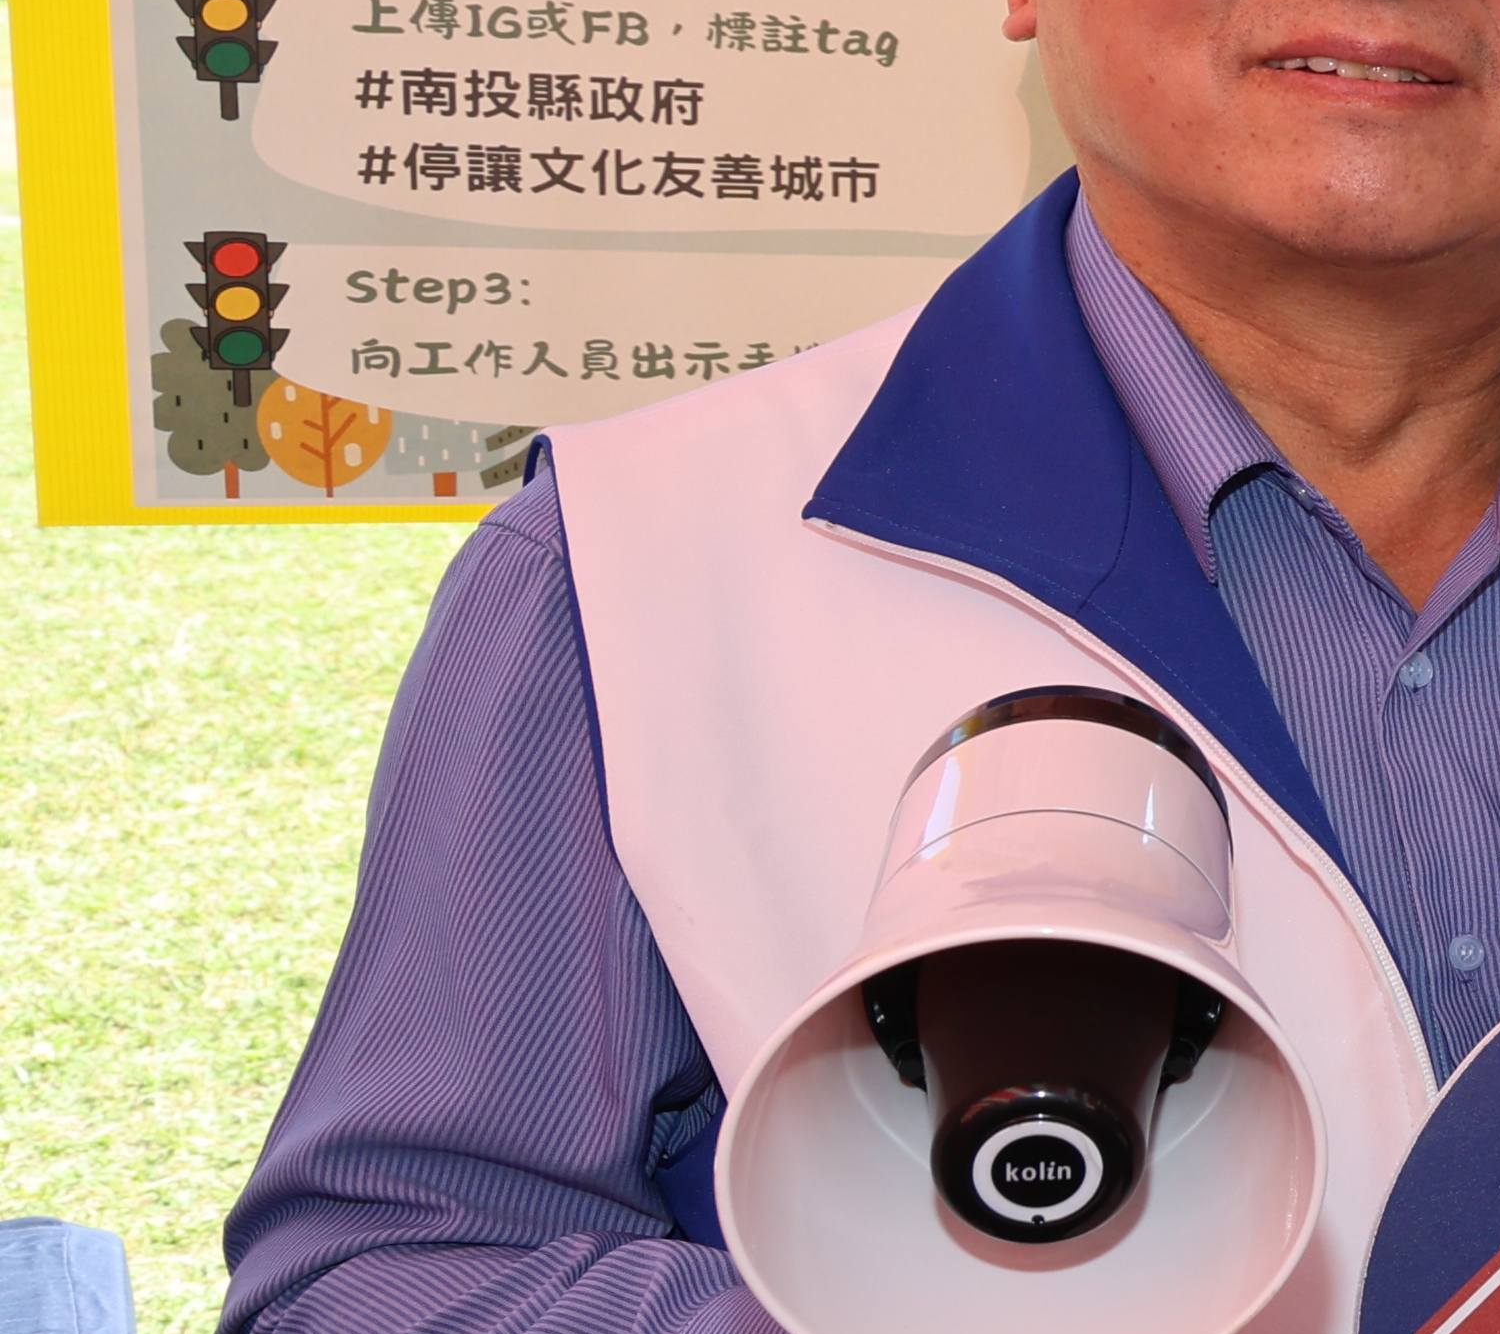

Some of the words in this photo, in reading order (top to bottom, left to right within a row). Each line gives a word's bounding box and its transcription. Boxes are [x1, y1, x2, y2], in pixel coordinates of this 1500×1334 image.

[355, 68, 705, 127] #南投縣政府
[357, 143, 880, 204] #停讓文化友善城市
[345, 268, 532, 314] Step3:
[351, 339, 825, 380] 向工作人員出示手
[1004, 1158, 1073, 1185] kolin
